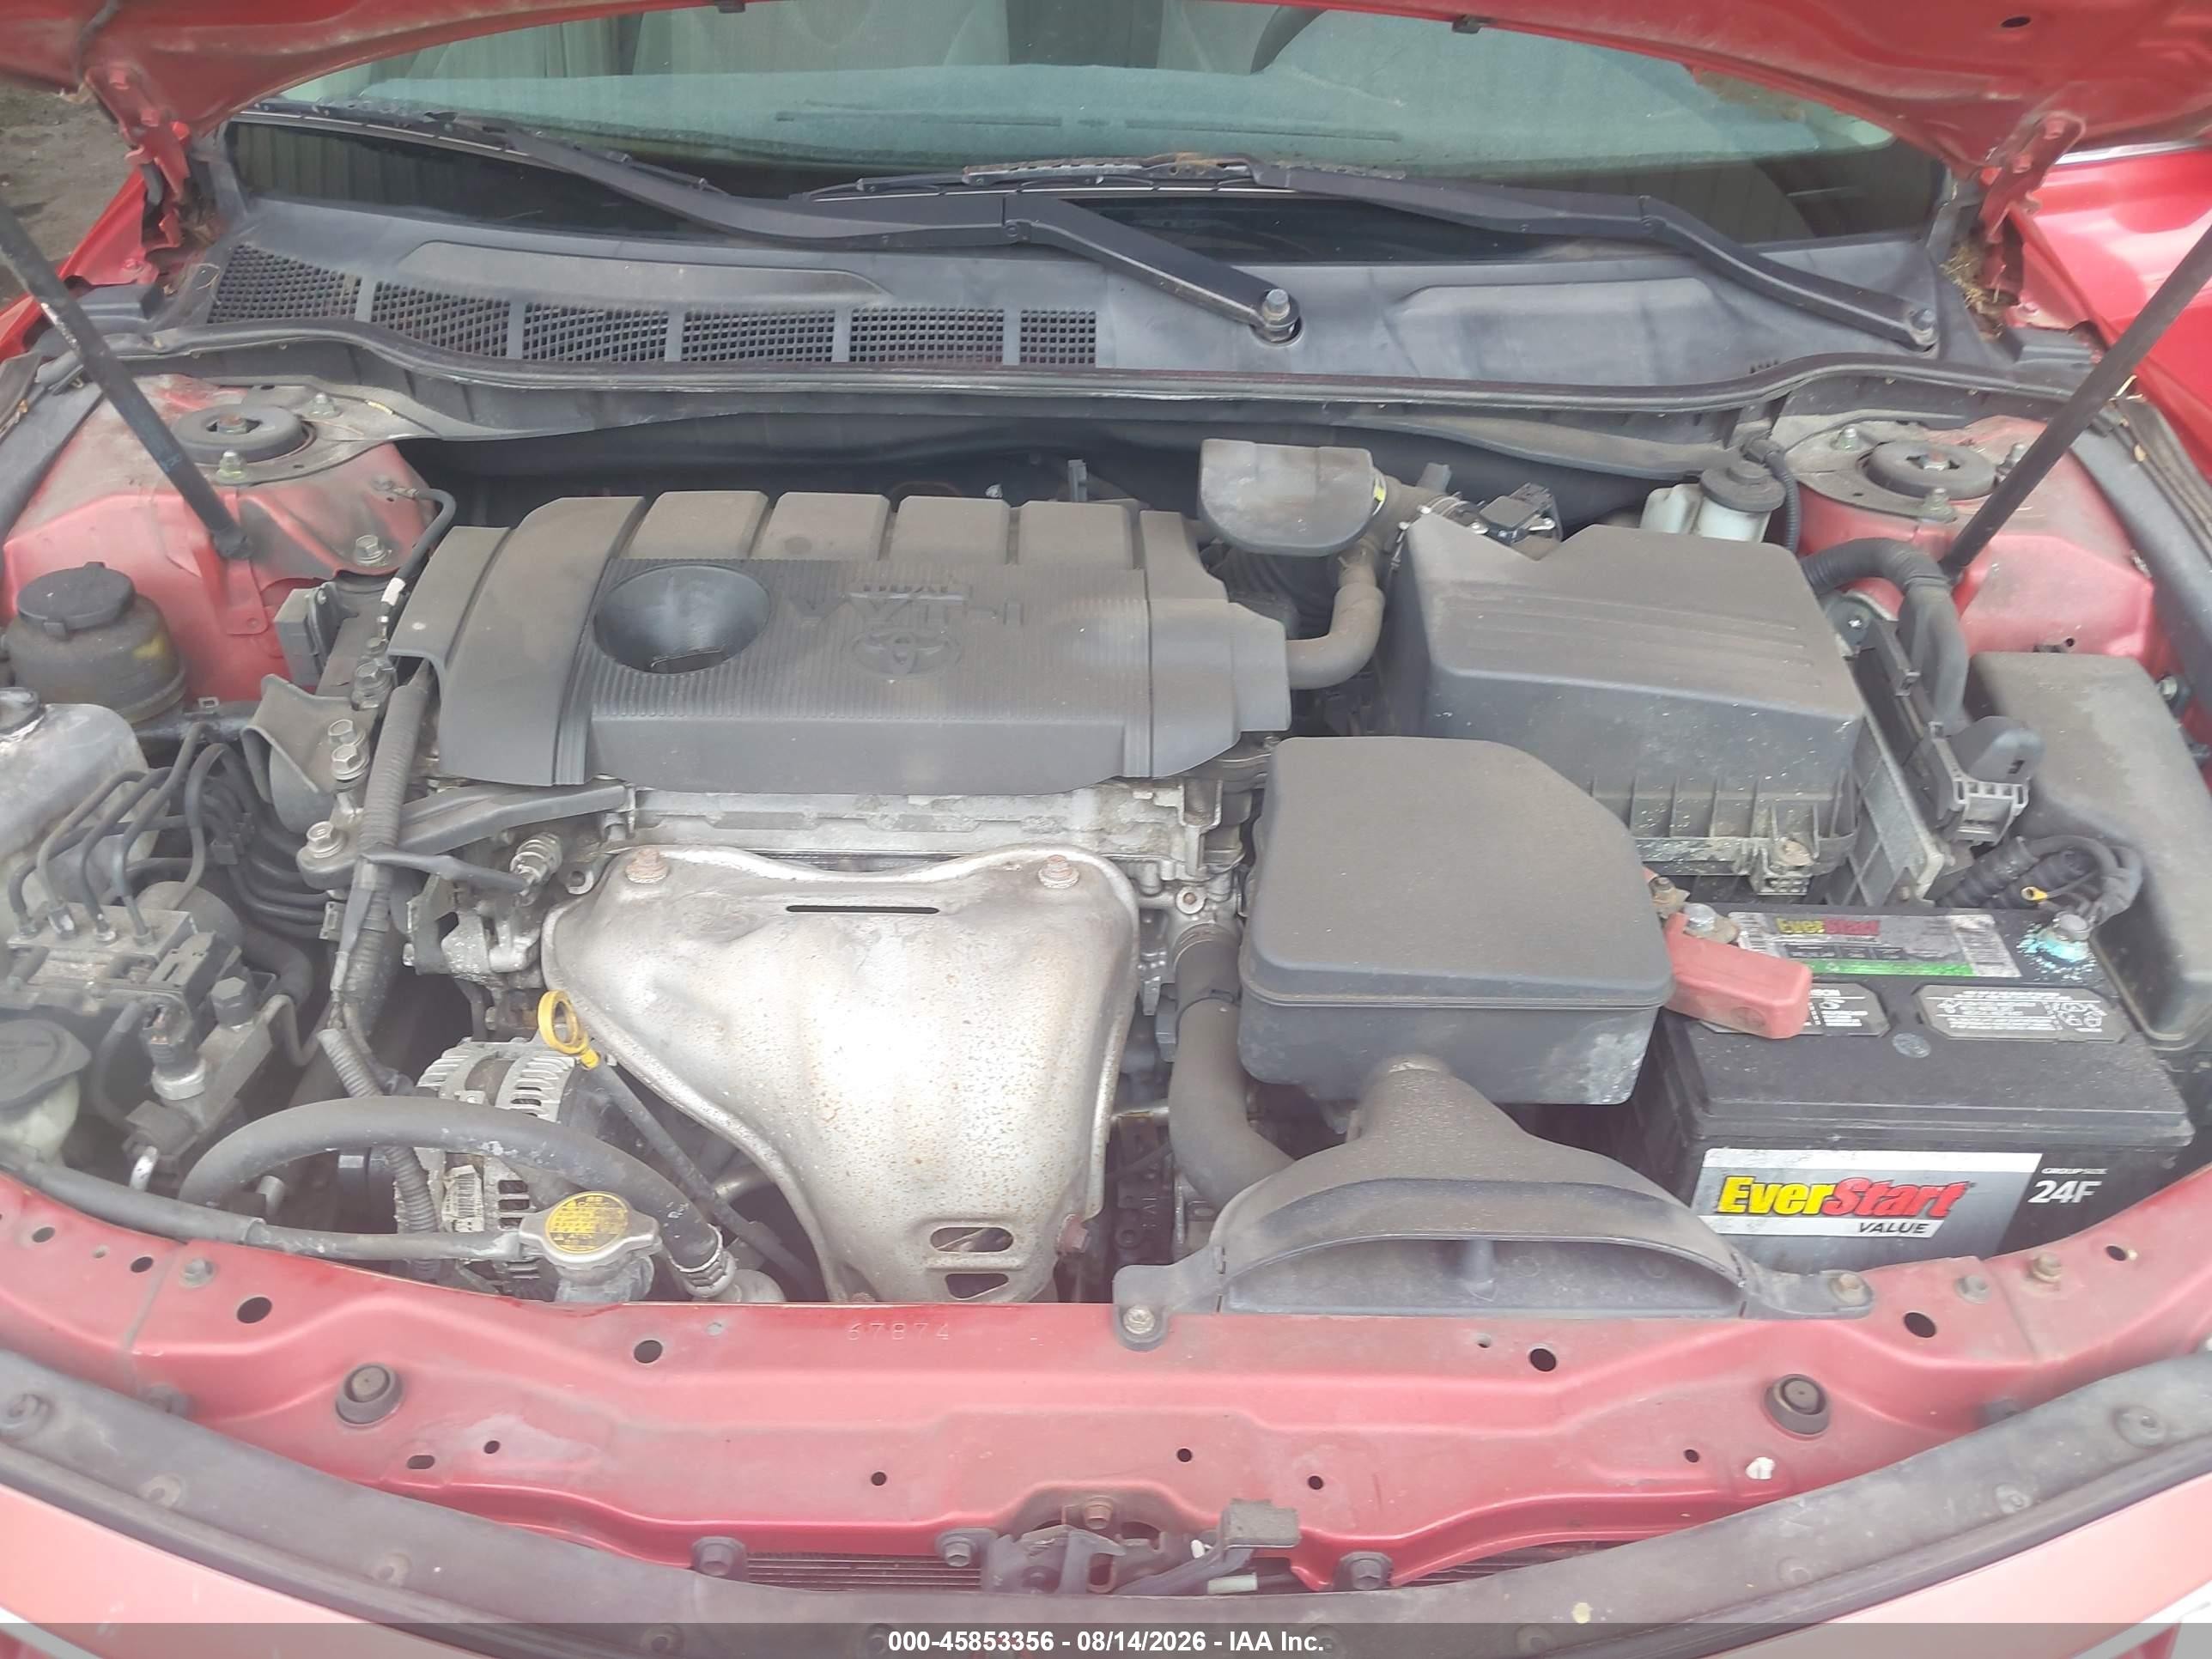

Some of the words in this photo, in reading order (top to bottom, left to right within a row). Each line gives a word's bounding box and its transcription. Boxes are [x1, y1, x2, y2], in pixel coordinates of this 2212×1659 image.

[1717, 1176, 1970, 1218] EverStart
[2027, 1180, 2103, 1204] 24F
[1857, 1221, 1934, 1235] VALUE
[848, 1322, 951, 1341] 67874
